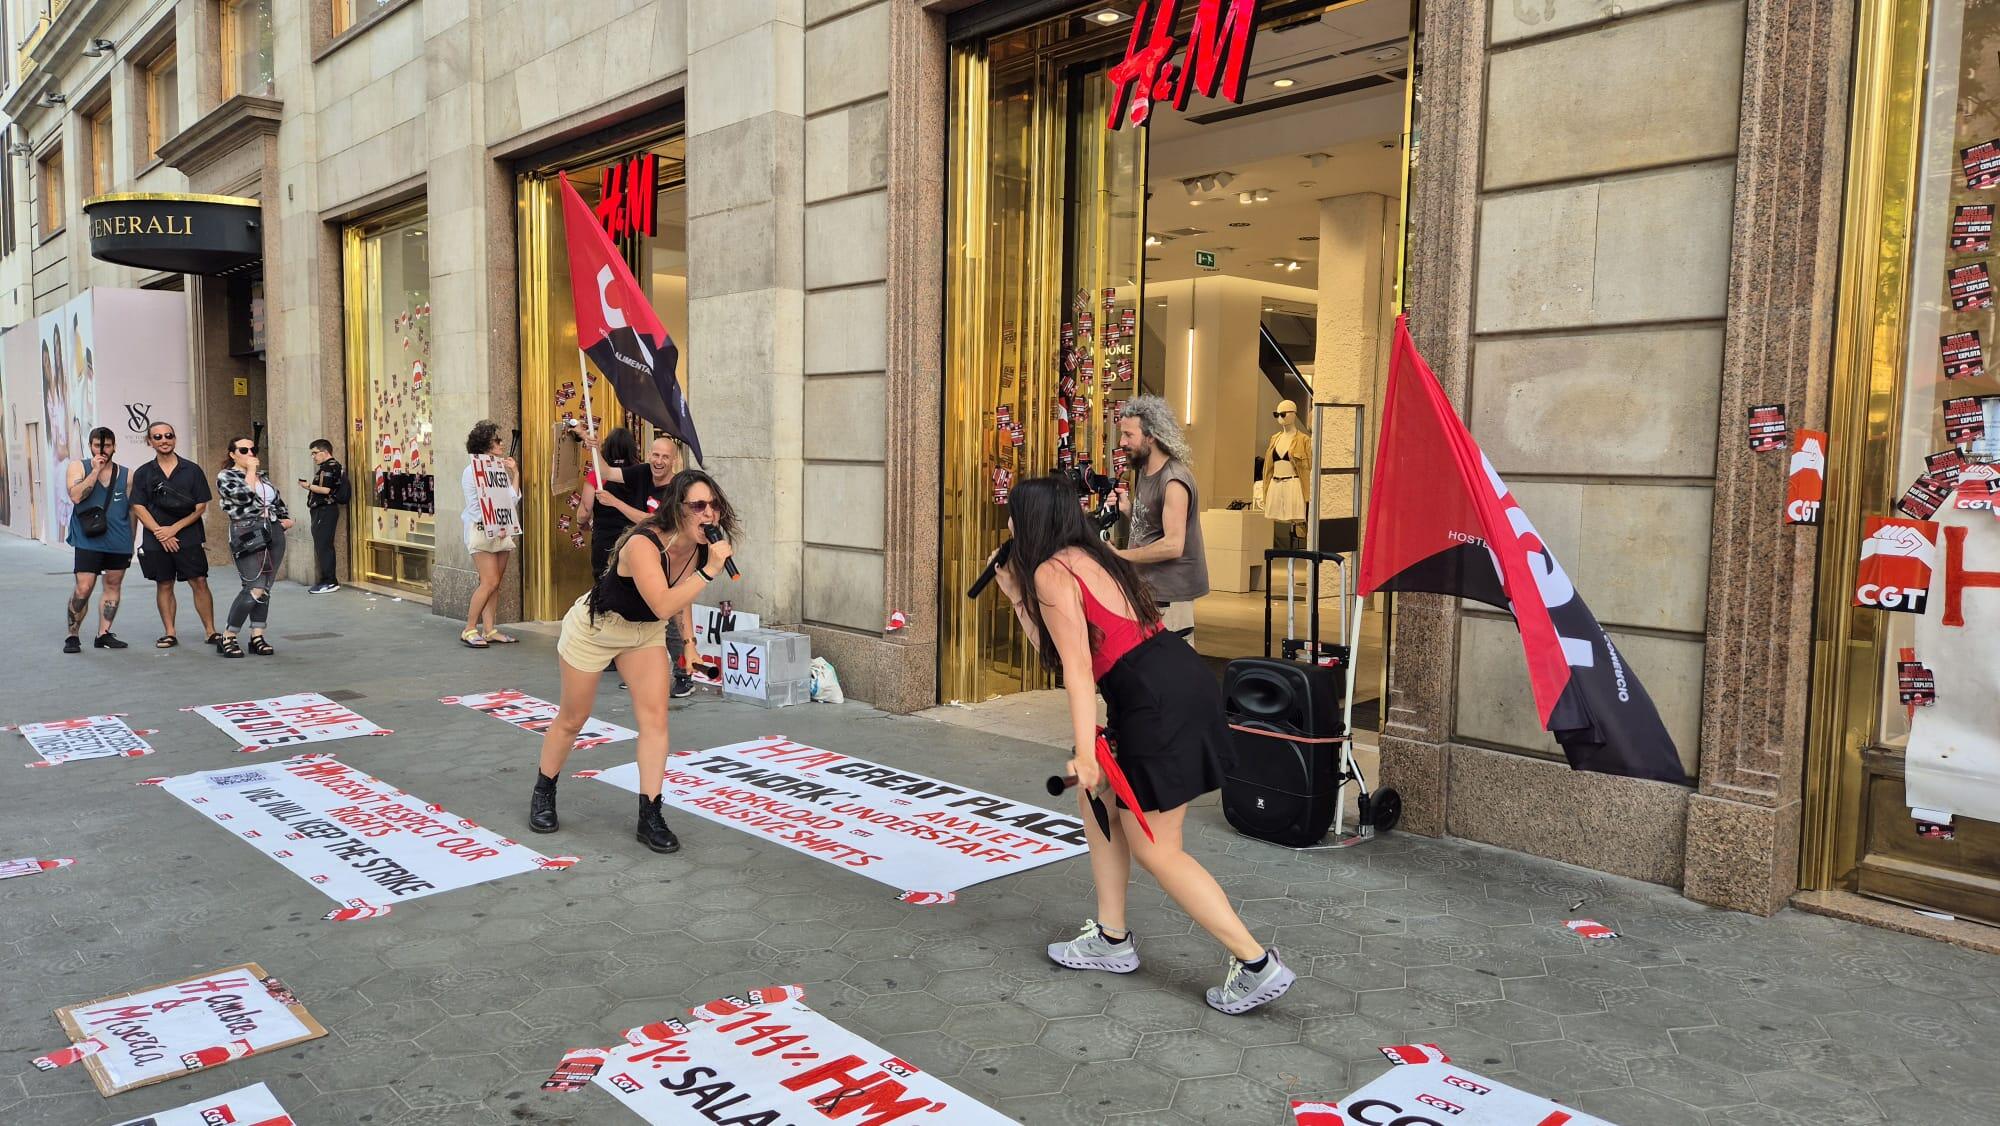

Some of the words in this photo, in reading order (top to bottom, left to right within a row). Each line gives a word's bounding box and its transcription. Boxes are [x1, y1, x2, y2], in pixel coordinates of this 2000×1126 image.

[1107, 0, 1257, 130] H&M
[595, 153, 656, 242] H&M
[480, 497, 513, 526] MISERY
[1787, 499, 1820, 522] CGT
[1957, 499, 1992, 509] CGT
[1857, 584, 1926, 610] CGT
[212, 702, 307, 745] EXPLOITS
[686, 756, 752, 773] TO
[825, 762, 966, 799] GREAT
[240, 787, 285, 802] WE
[258, 799, 311, 821] WILL
[709, 786, 844, 829] WORKLOAD
[288, 818, 348, 839] KEEP
[325, 805, 402, 838] RIGHTS
[369, 803, 459, 838] RESPECT
[437, 837, 499, 862] OUR
[683, 796, 797, 834] ABUSIVE
[780, 830, 884, 867] SHIFTS
[831, 803, 1021, 864] UNDERSTAFF
[913, 811, 1064, 854] ANXIETY
[324, 838, 380, 861] THE
[352, 857, 436, 896] STRIKE
[32, 1056, 59, 1072] CGT
[182, 1053, 204, 1070] CGT
[1382, 1047, 1408, 1065] CGT
[883, 1061, 914, 1077] CGT
[613, 1075, 640, 1092] CGT
[627, 1039, 691, 1069] 1%
[659, 1066, 797, 1126] SALA
[1447, 1077, 1490, 1095] CGT
[1420, 1096, 1464, 1114] CGT
